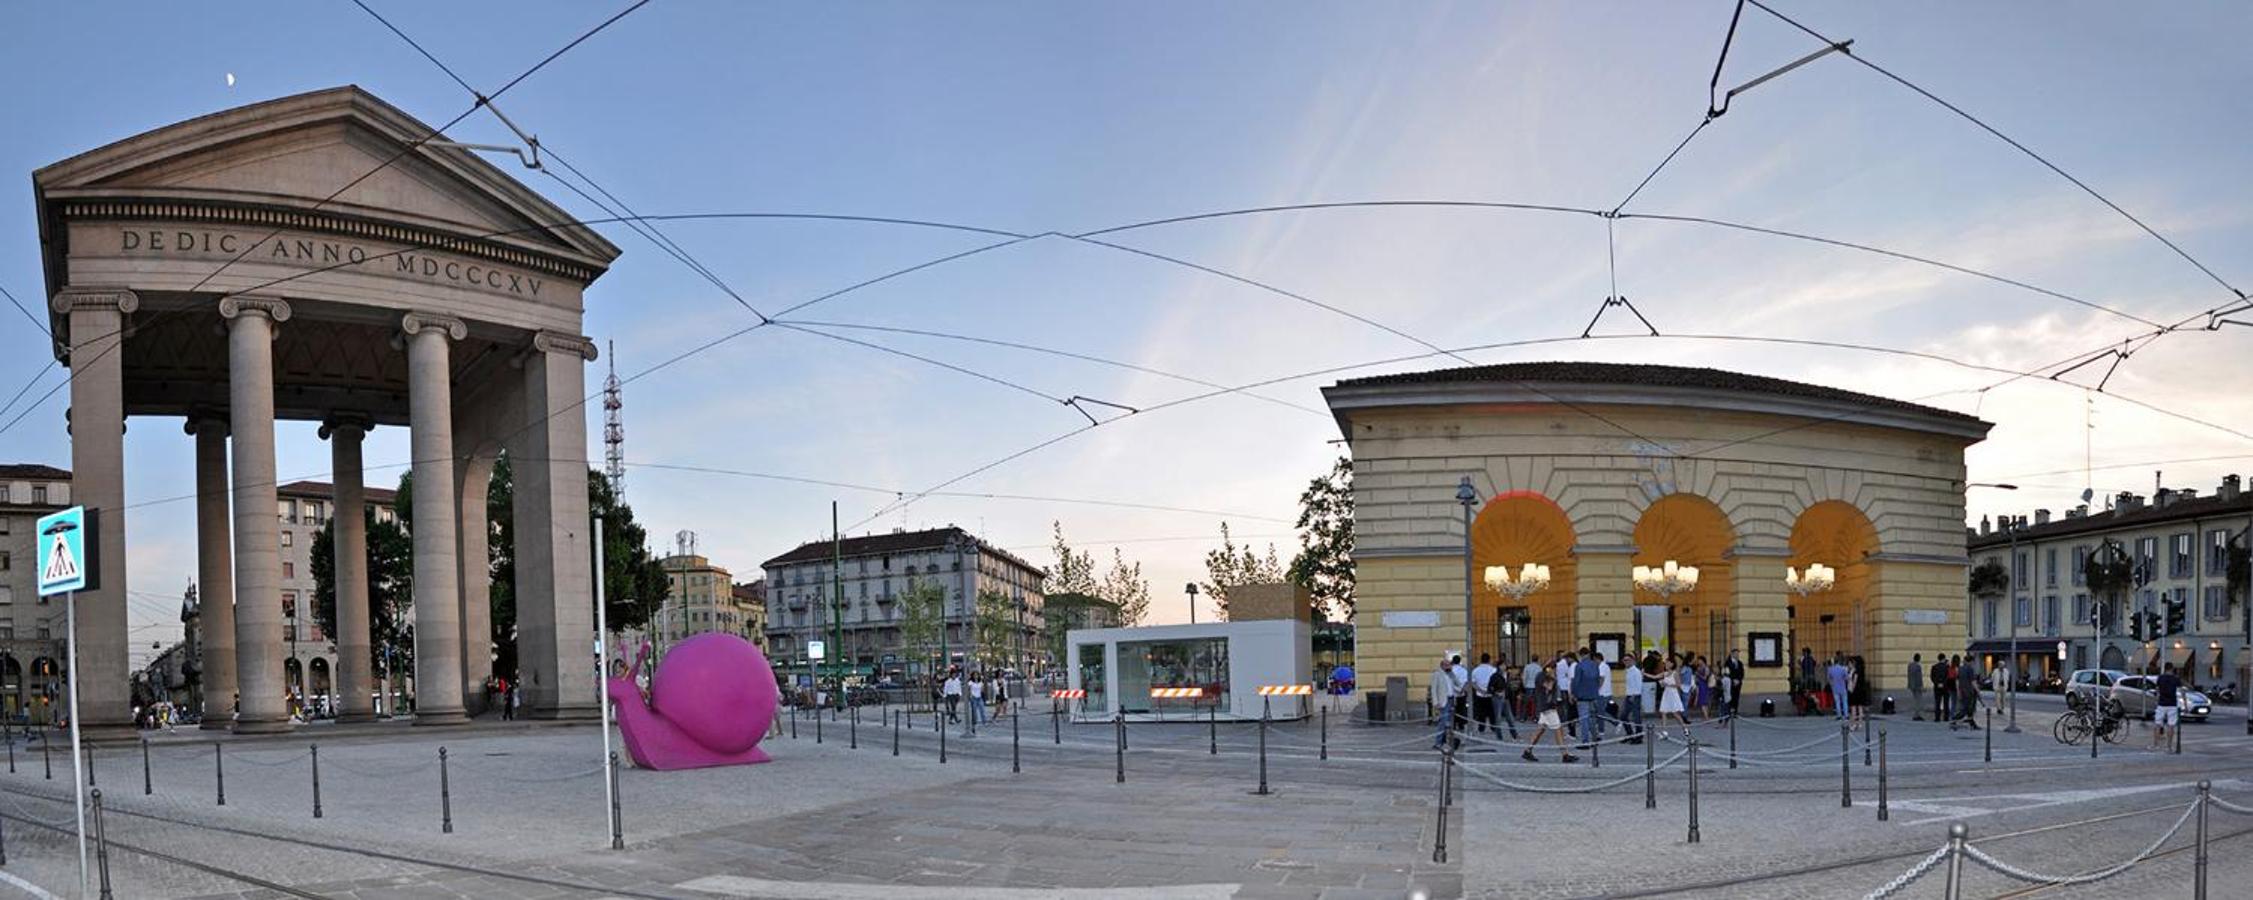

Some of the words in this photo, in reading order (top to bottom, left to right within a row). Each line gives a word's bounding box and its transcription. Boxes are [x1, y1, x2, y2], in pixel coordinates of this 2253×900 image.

[121, 230, 237, 253] DEDIC
[272, 239, 366, 265] ANNO
[396, 251, 542, 296] MDCCCXV
